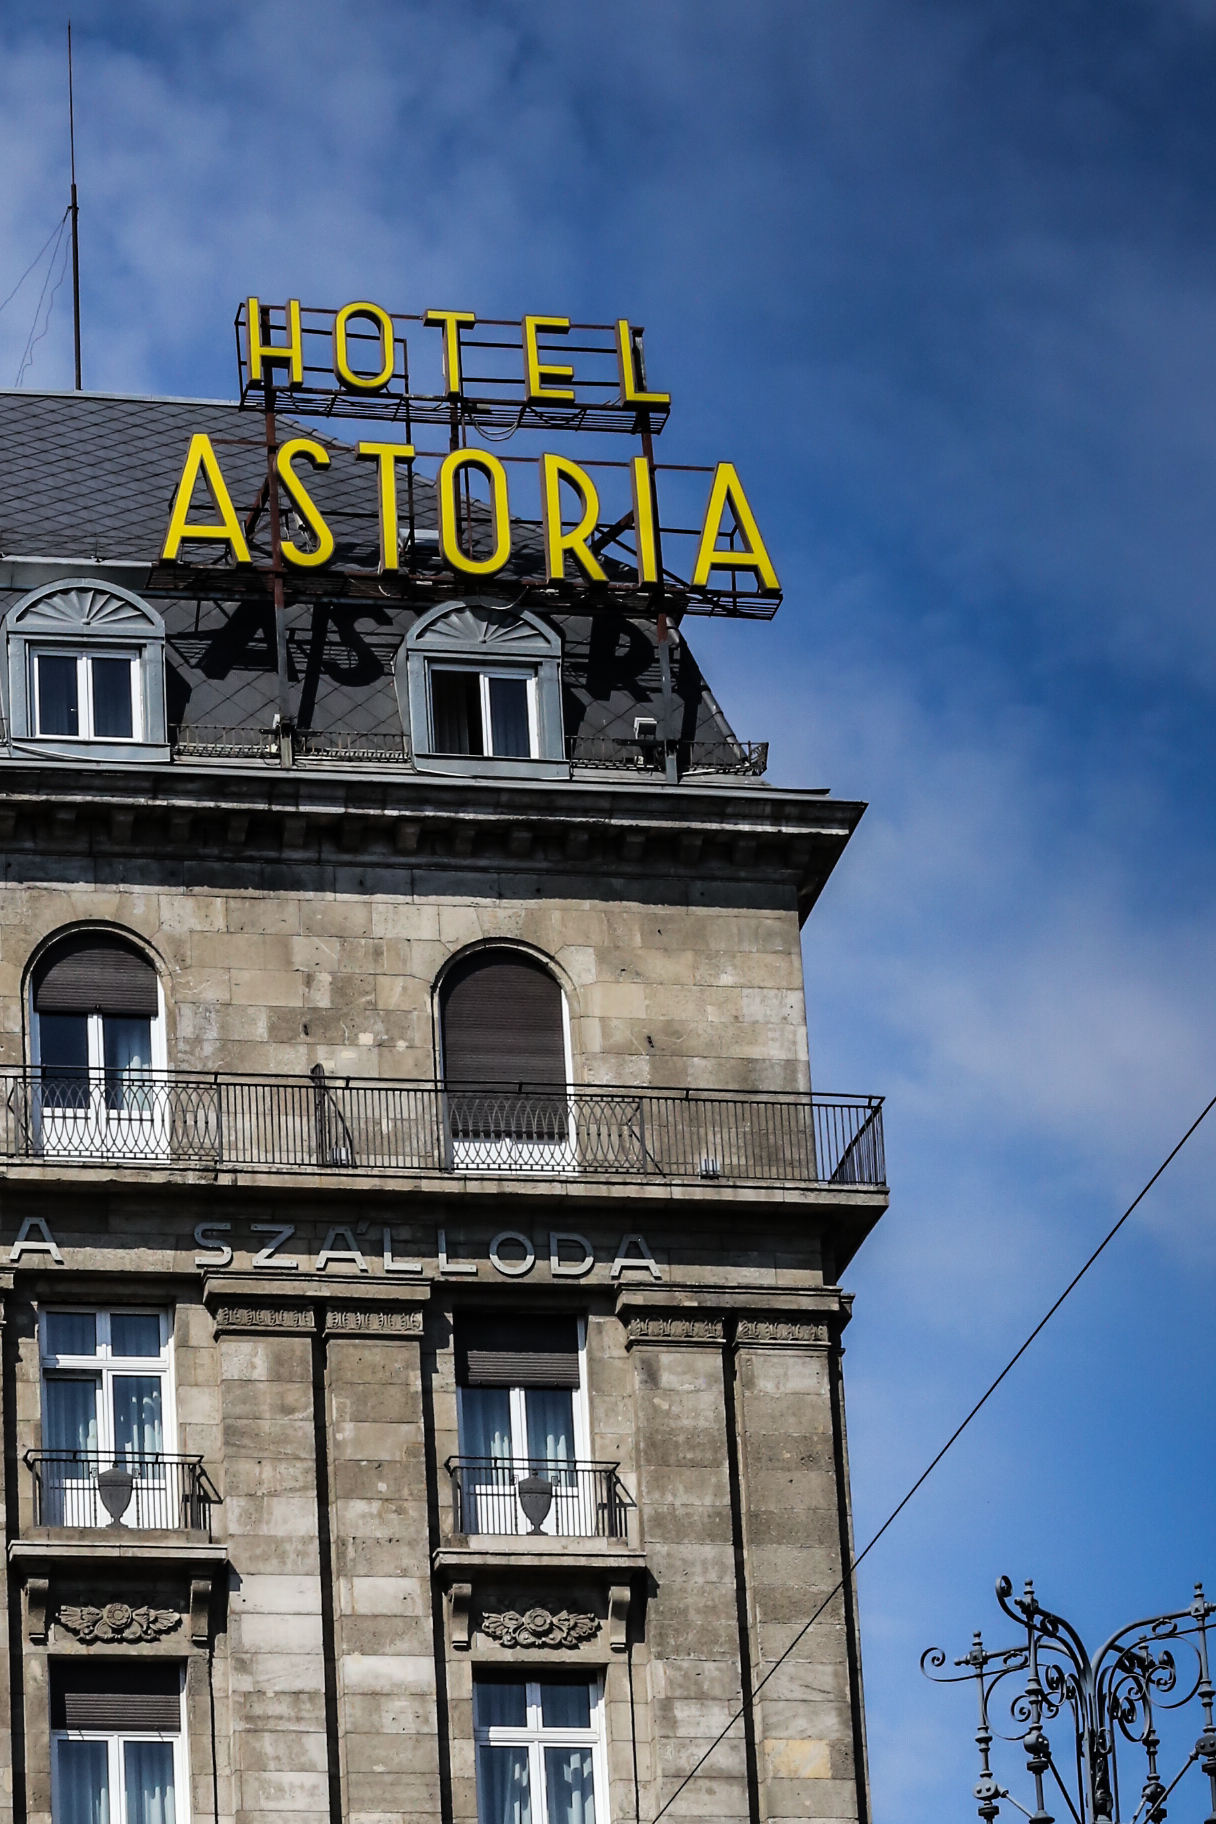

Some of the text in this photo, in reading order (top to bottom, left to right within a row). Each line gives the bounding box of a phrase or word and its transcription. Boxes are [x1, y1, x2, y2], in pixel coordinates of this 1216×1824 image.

[245, 296, 671, 408] HOTEL
[158, 433, 782, 593] ASTORIA
[193, 1218, 664, 1280] SZÁLLODA
